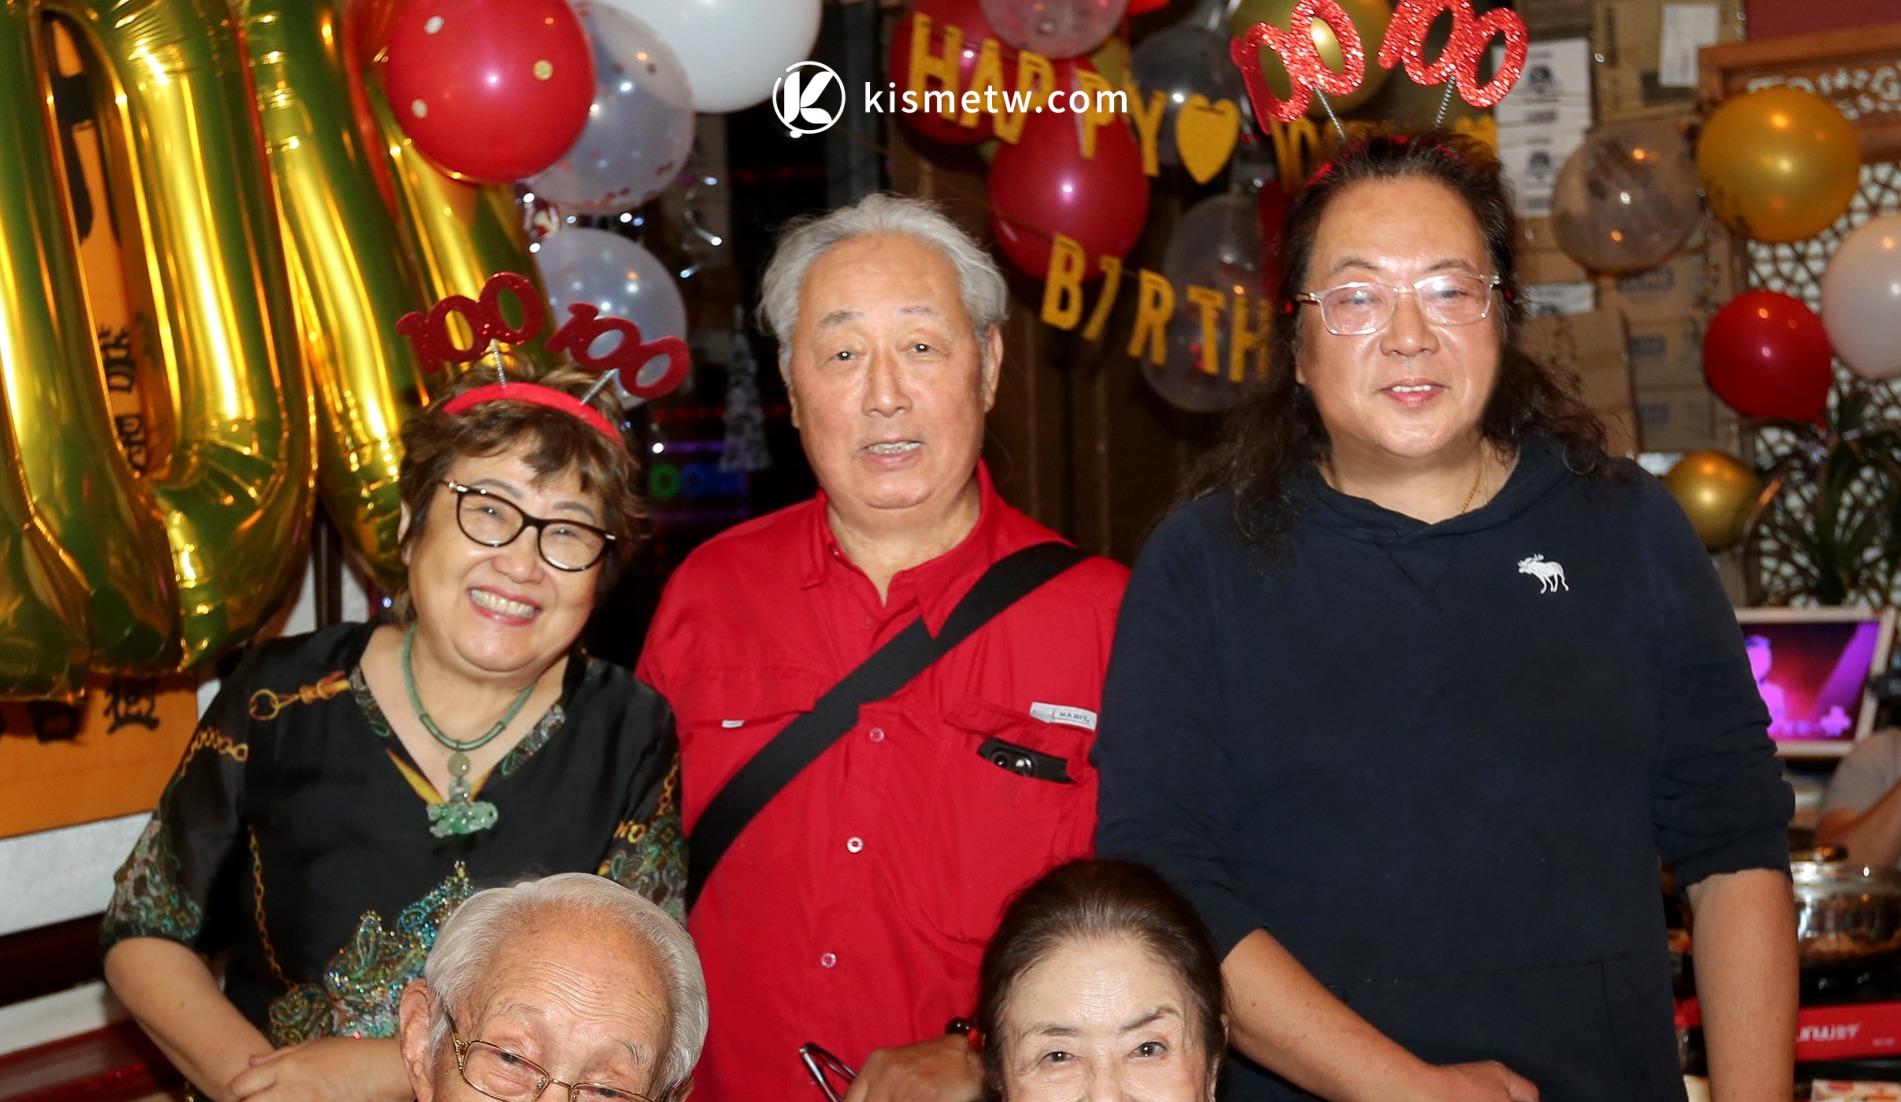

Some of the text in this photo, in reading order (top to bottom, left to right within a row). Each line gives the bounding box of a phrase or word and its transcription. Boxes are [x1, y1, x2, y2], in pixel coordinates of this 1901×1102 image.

[908, 13, 1168, 177] HAPPY
[396, 271, 544, 374] 100
[545, 302, 692, 398] 100
